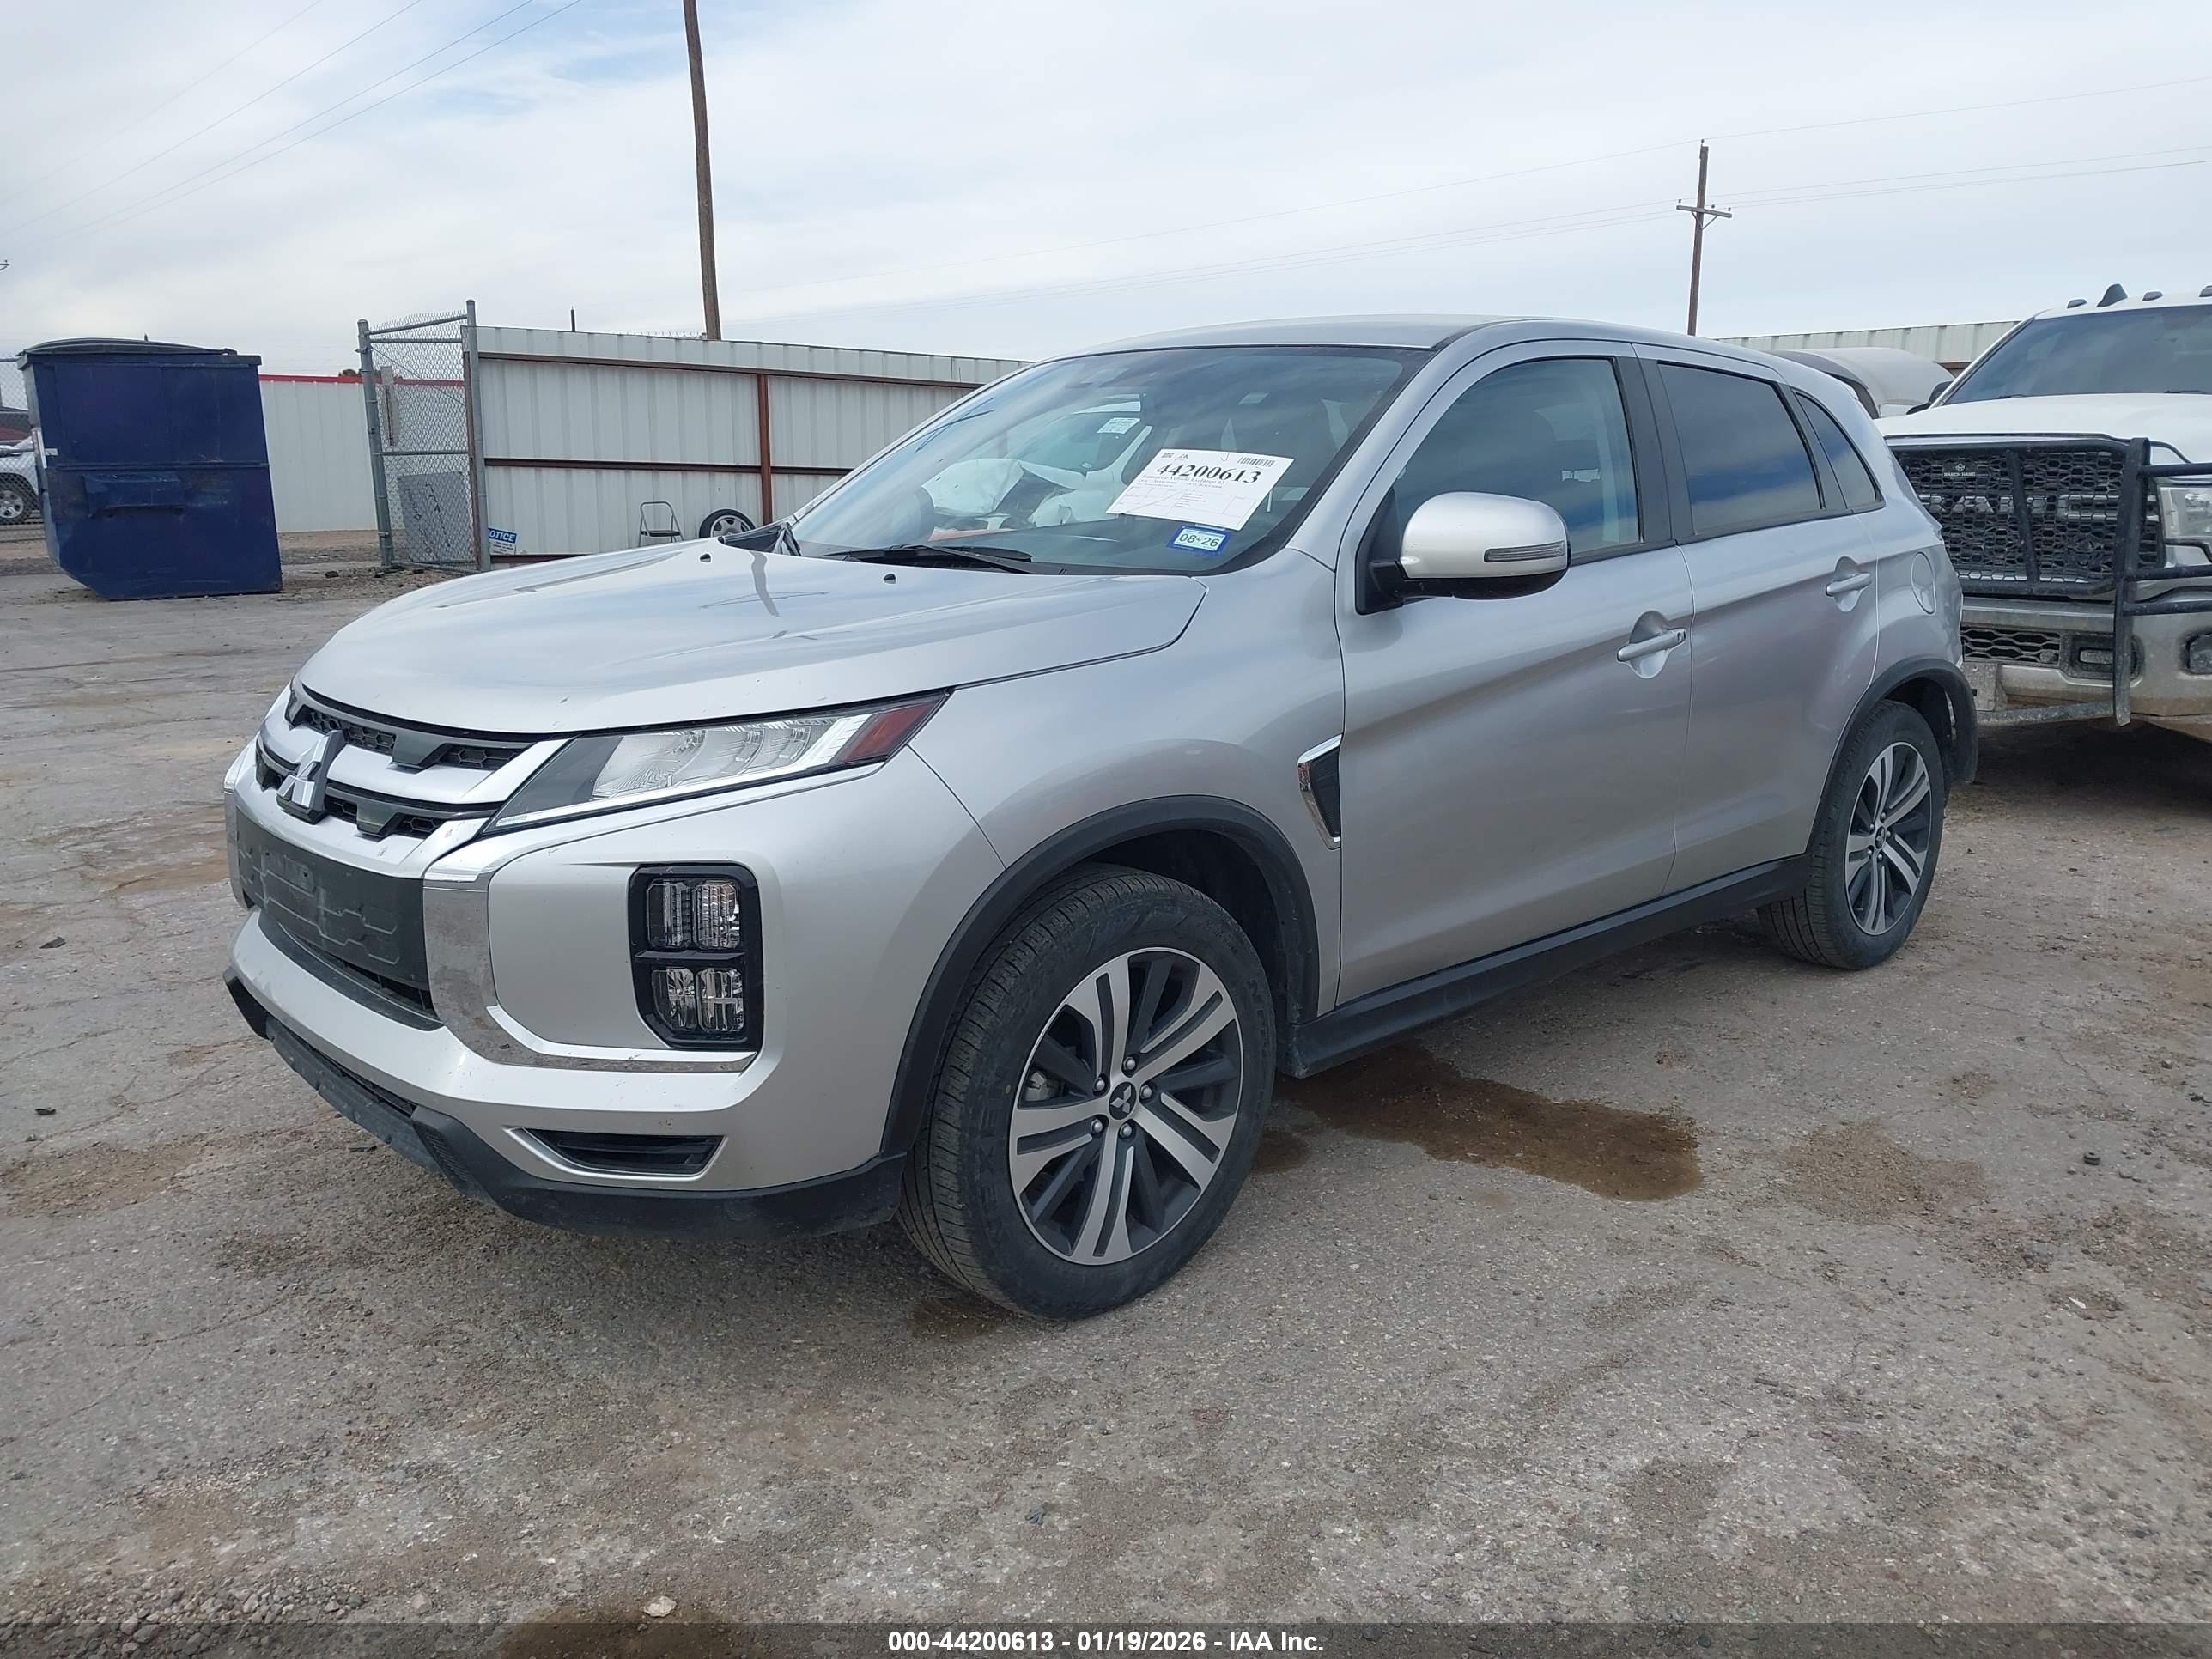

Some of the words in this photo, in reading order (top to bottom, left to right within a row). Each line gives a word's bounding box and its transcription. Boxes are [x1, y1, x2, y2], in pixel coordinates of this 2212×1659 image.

[1156, 463, 1261, 484] 44200613
[488, 529, 516, 542] OTICE
[1179, 533, 1197, 543] 08
[1200, 537, 1220, 547] 26
